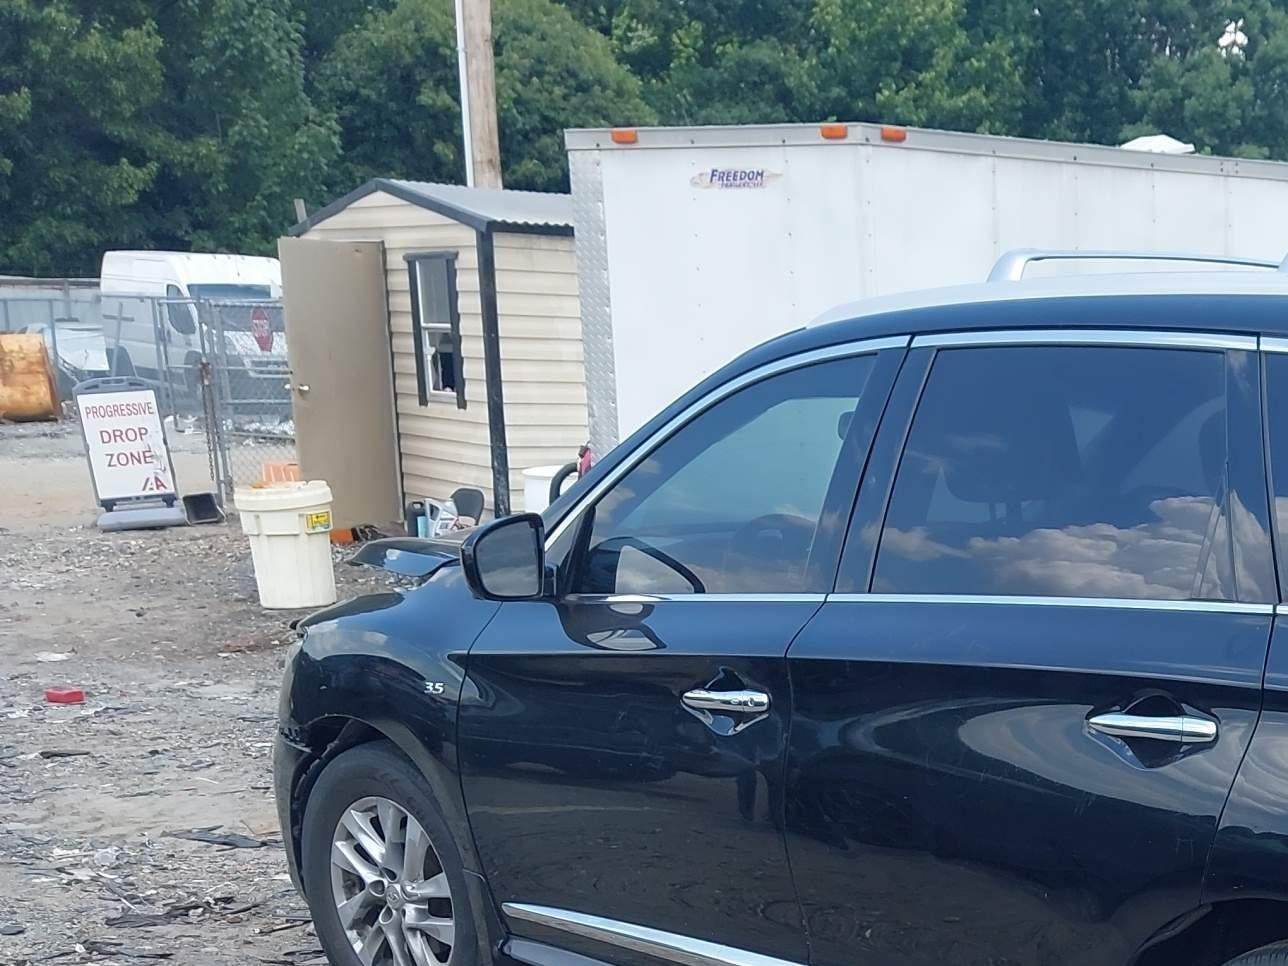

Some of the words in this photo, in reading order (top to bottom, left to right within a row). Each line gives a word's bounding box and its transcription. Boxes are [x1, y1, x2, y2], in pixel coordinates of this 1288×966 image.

[710, 169, 764, 183] FREEDOM
[85, 402, 154, 418] PROGRESSIVE
[99, 426, 149, 444] DROP
[106, 450, 155, 467] ZONE
